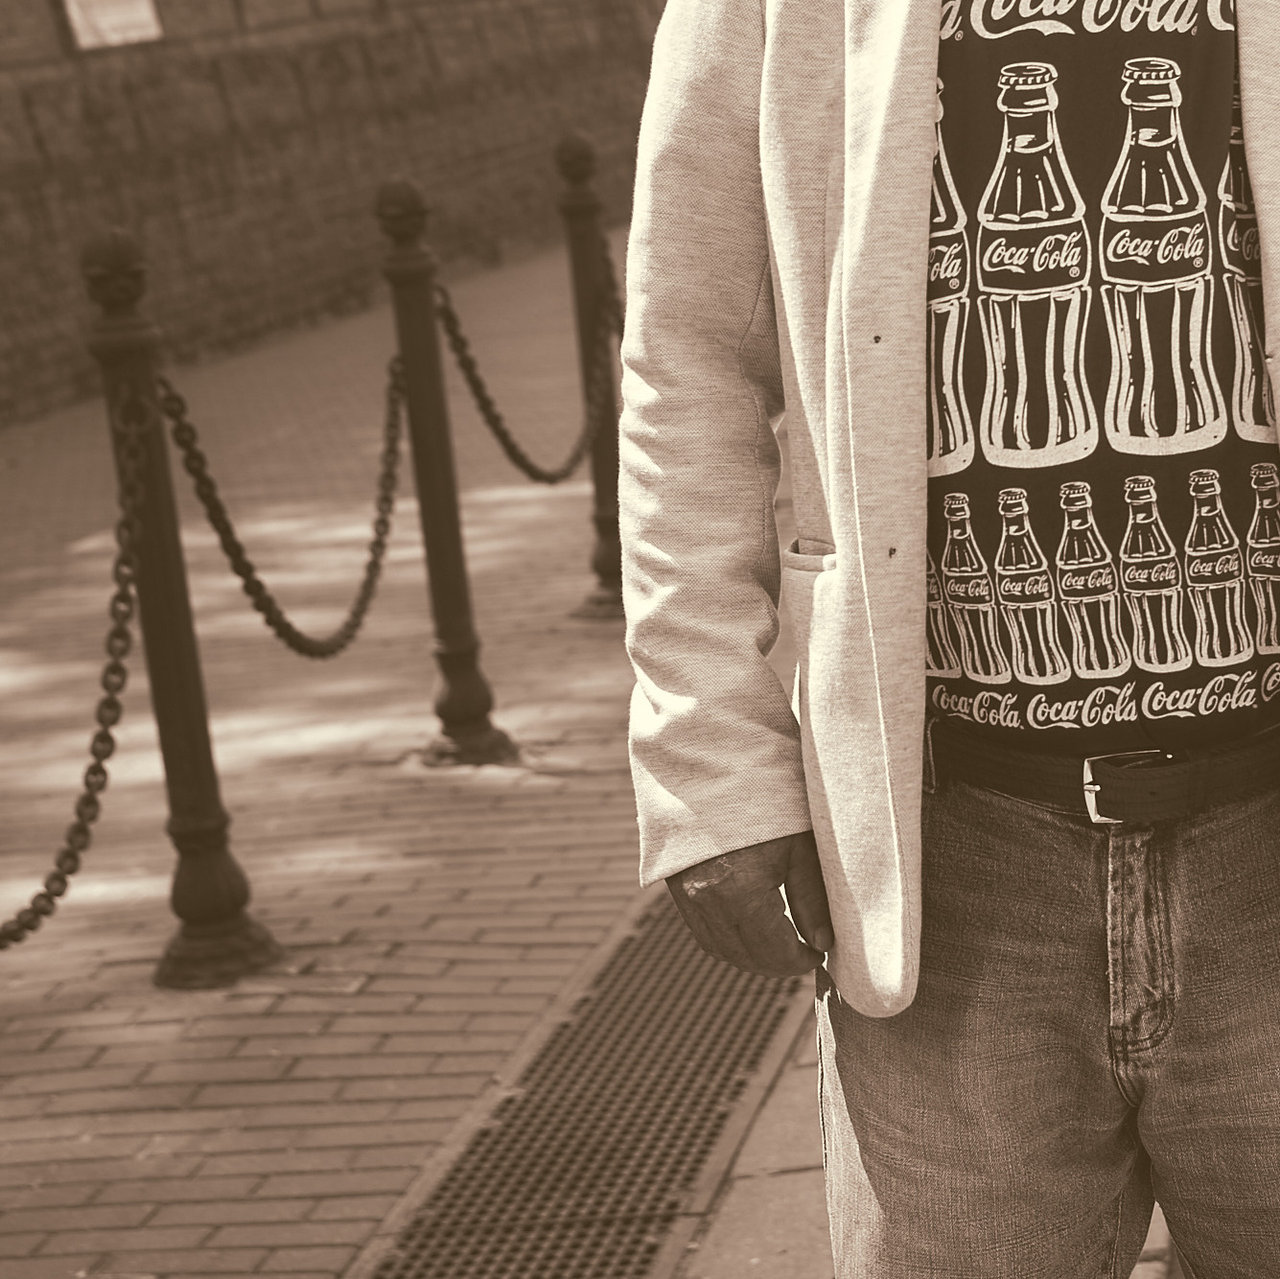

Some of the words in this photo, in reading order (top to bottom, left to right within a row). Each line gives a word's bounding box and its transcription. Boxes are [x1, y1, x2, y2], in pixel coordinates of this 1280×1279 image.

[982, 230, 1083, 274] Coca-Cola
[1106, 222, 1205, 266] Coca-Cola
[1125, 561, 1176, 583] Coca-Cola
[1189, 553, 1239, 576] Coca-Cola
[947, 578, 989, 597] Coca-Cola
[1000, 574, 1049, 596] Coca-Cola
[1061, 567, 1113, 590] Coca-Cola
[932, 684, 1021, 729] Coca-Cola
[1026, 680, 1138, 730] Coca-Cola
[1141, 670, 1258, 720] Coca-Cola
